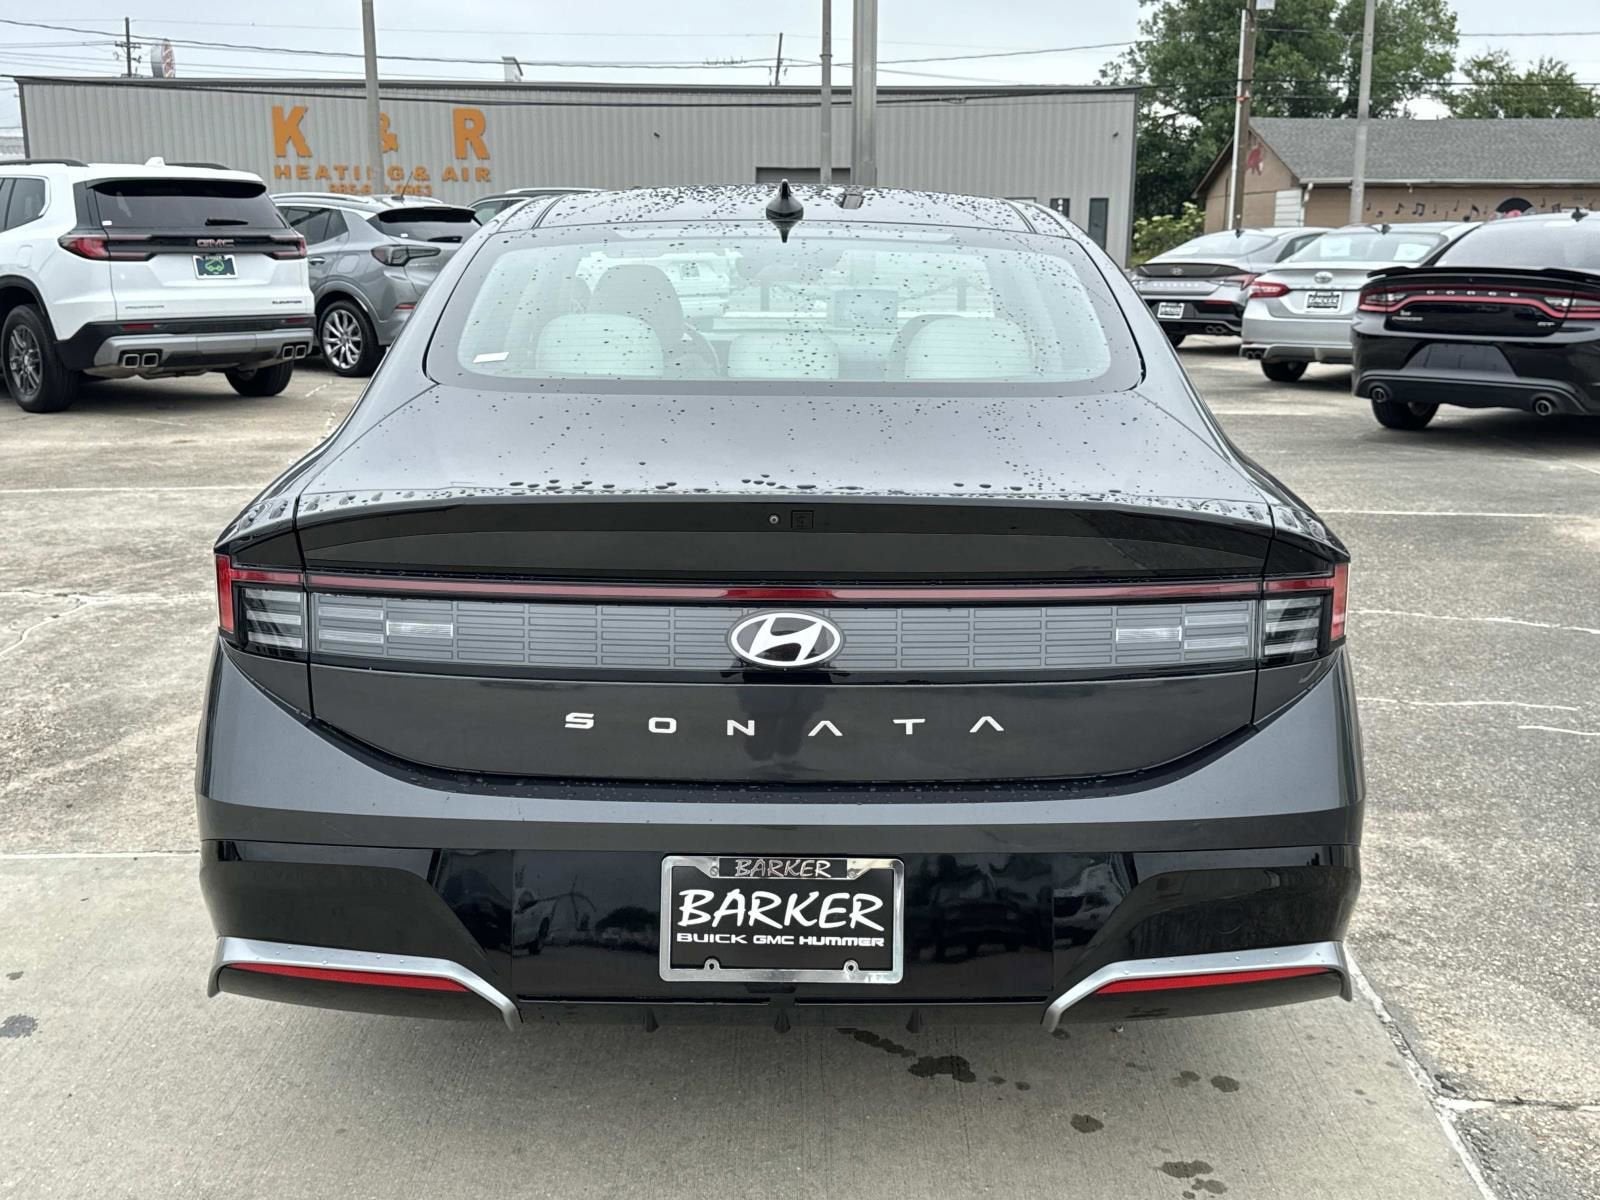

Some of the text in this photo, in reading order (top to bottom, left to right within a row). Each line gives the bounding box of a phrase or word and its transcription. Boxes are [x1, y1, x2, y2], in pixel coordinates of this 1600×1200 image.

[271, 105, 312, 158] K
[452, 107, 490, 160] R
[274, 164, 491, 182] HEATIG & AIR
[196, 238, 235, 248] GMC
[564, 712, 1005, 737] SONATA
[735, 858, 832, 878] BARKER
[677, 888, 885, 931] BARKER
[676, 932, 885, 947] BUICK GMC HUMMER
